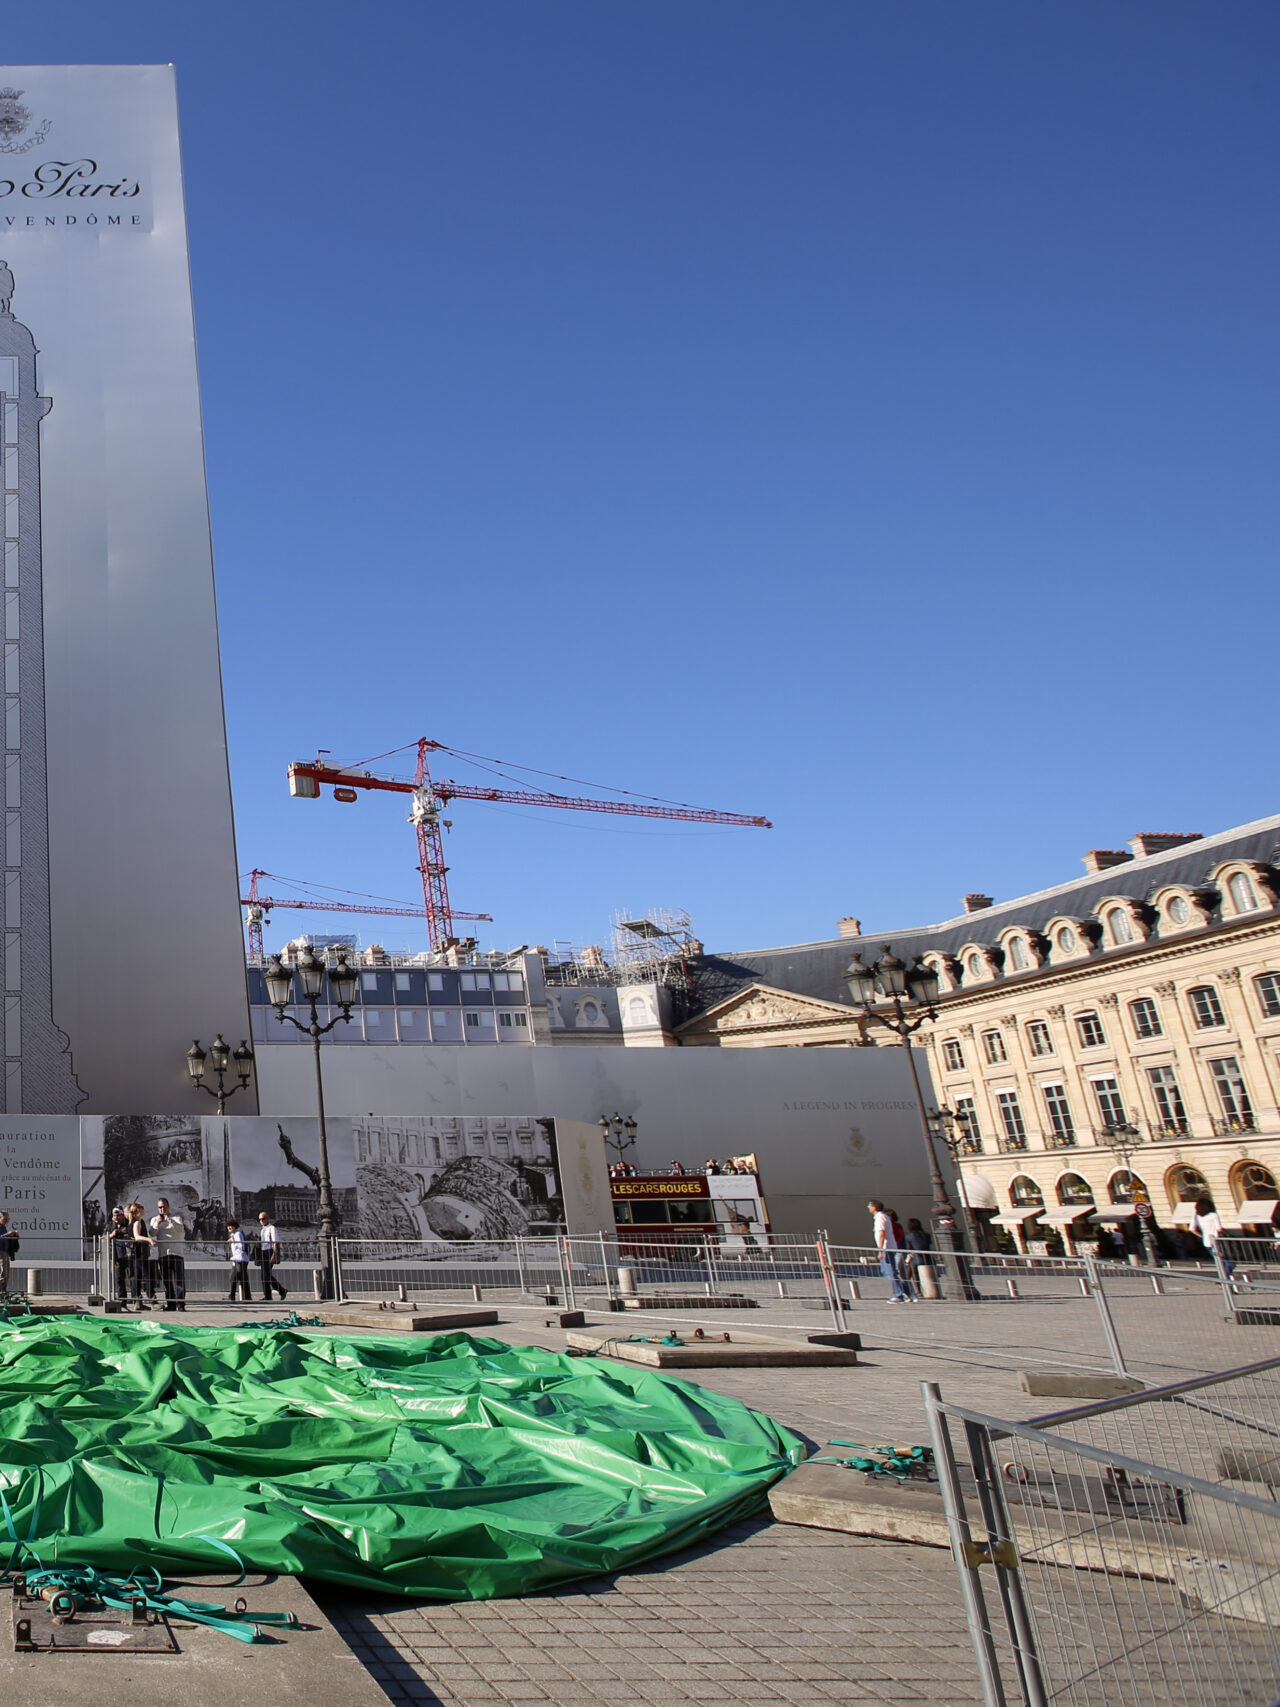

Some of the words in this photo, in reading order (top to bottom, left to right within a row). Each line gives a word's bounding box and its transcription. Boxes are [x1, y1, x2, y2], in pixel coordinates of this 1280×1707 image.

[21, 159, 140, 199] Paris
[5, 212, 141, 227] VENDÔME
[794, 1101, 840, 1111] LEGEND
[845, 1101, 857, 1111] IN
[862, 1101, 918, 1111] PROGRES
[7, 1145, 16, 1153] la
[3, 1157, 61, 1169] Vendôme
[4, 1185, 46, 1200] Paris
[11, 1218, 70, 1231] endôme
